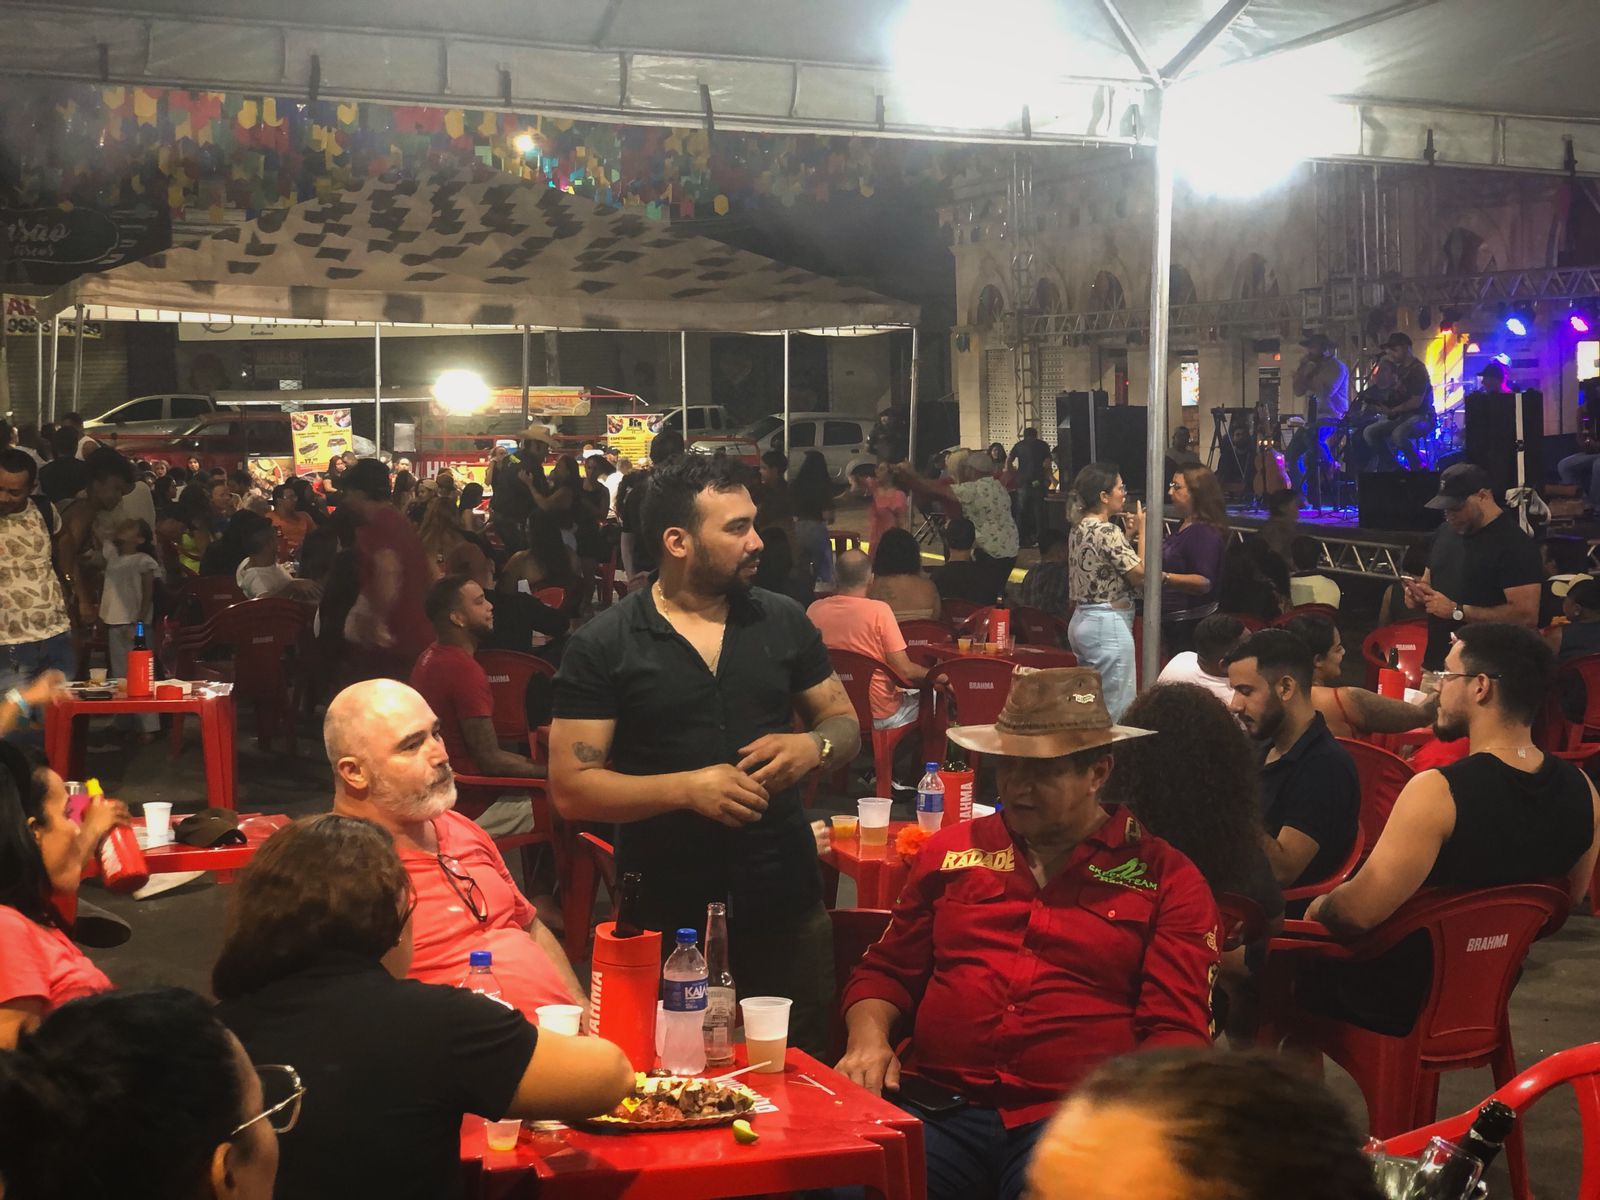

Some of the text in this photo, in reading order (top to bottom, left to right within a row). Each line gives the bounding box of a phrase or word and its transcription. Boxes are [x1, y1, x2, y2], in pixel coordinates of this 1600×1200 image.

[968, 681, 995, 690] BRAHMA
[959, 782, 974, 823] AHMA
[1466, 933, 1509, 952] BRAHMA
[587, 971, 603, 1038] AHMA
